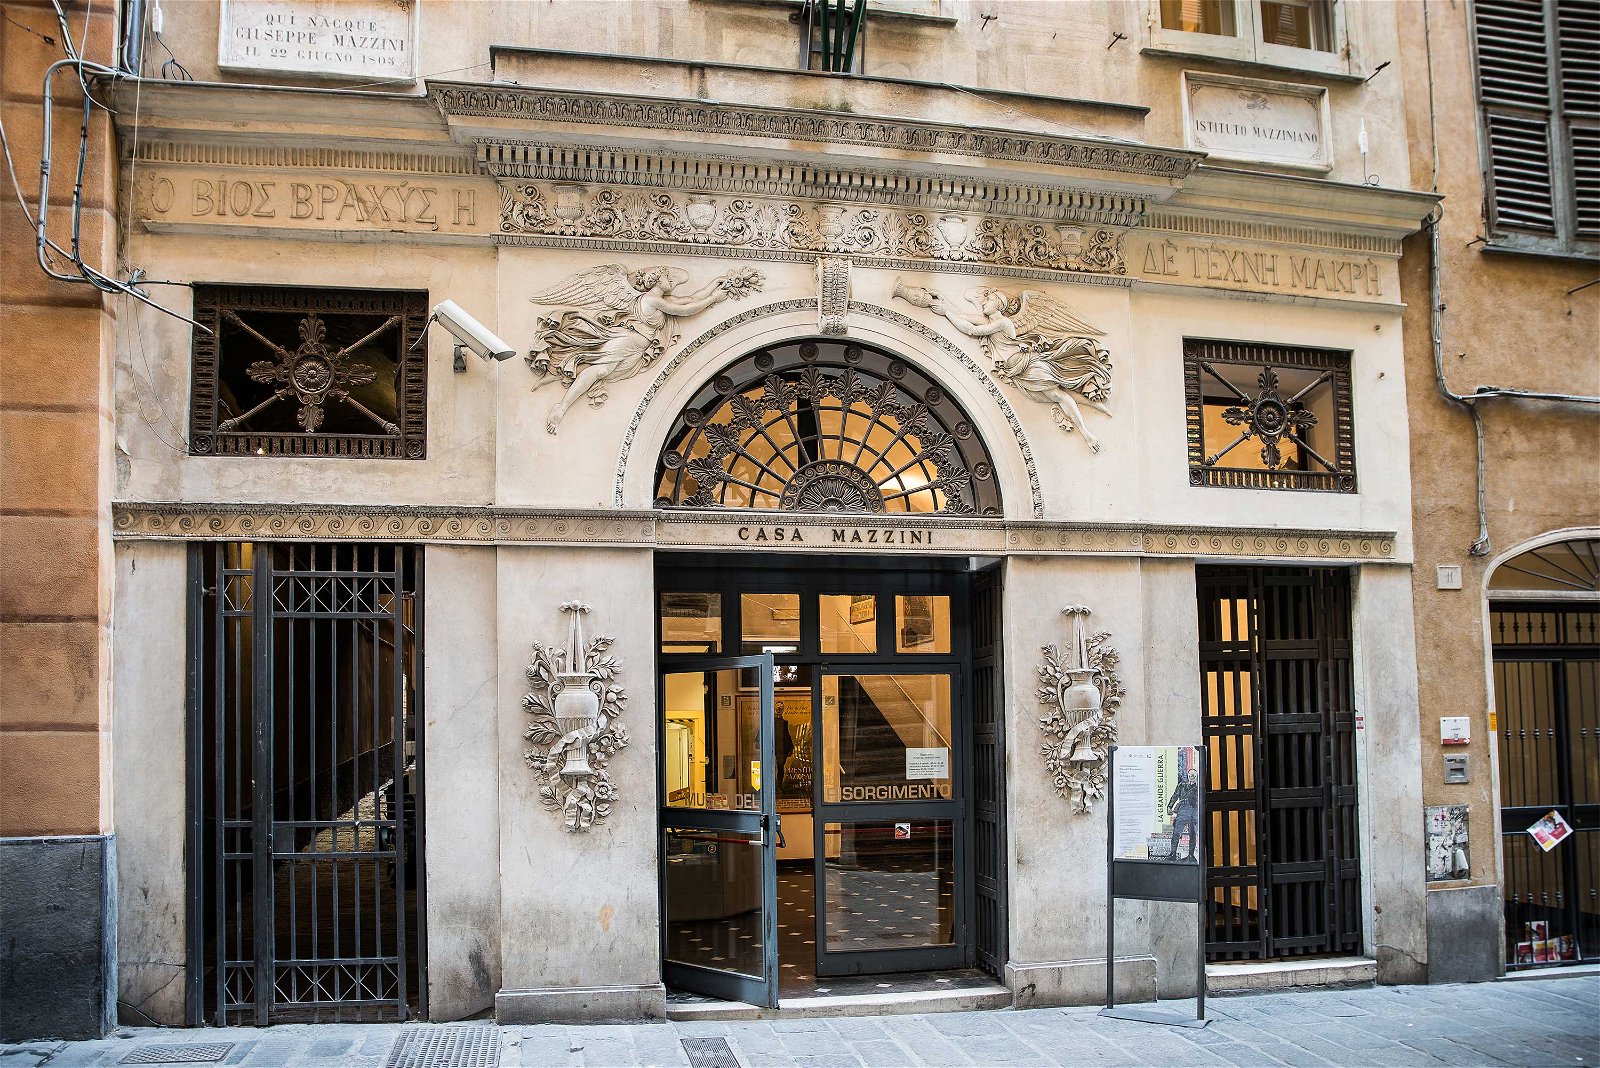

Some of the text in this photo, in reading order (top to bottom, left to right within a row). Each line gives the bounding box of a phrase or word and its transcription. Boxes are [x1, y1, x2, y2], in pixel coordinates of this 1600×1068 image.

[307, 17, 378, 32] NACQUE
[235, 28, 405, 52] GIUSEPPE MAZZINI
[245, 46, 261, 57] IL
[270, 49, 287, 58] 22
[297, 51, 353, 63] GIUGNO
[1195, 120, 1318, 143] ISTITUTO MAZZINIANO
[737, 527, 933, 544] CASA MAZZINI
[735, 793, 761, 809] DEL
[1157, 814, 1164, 823] LA
